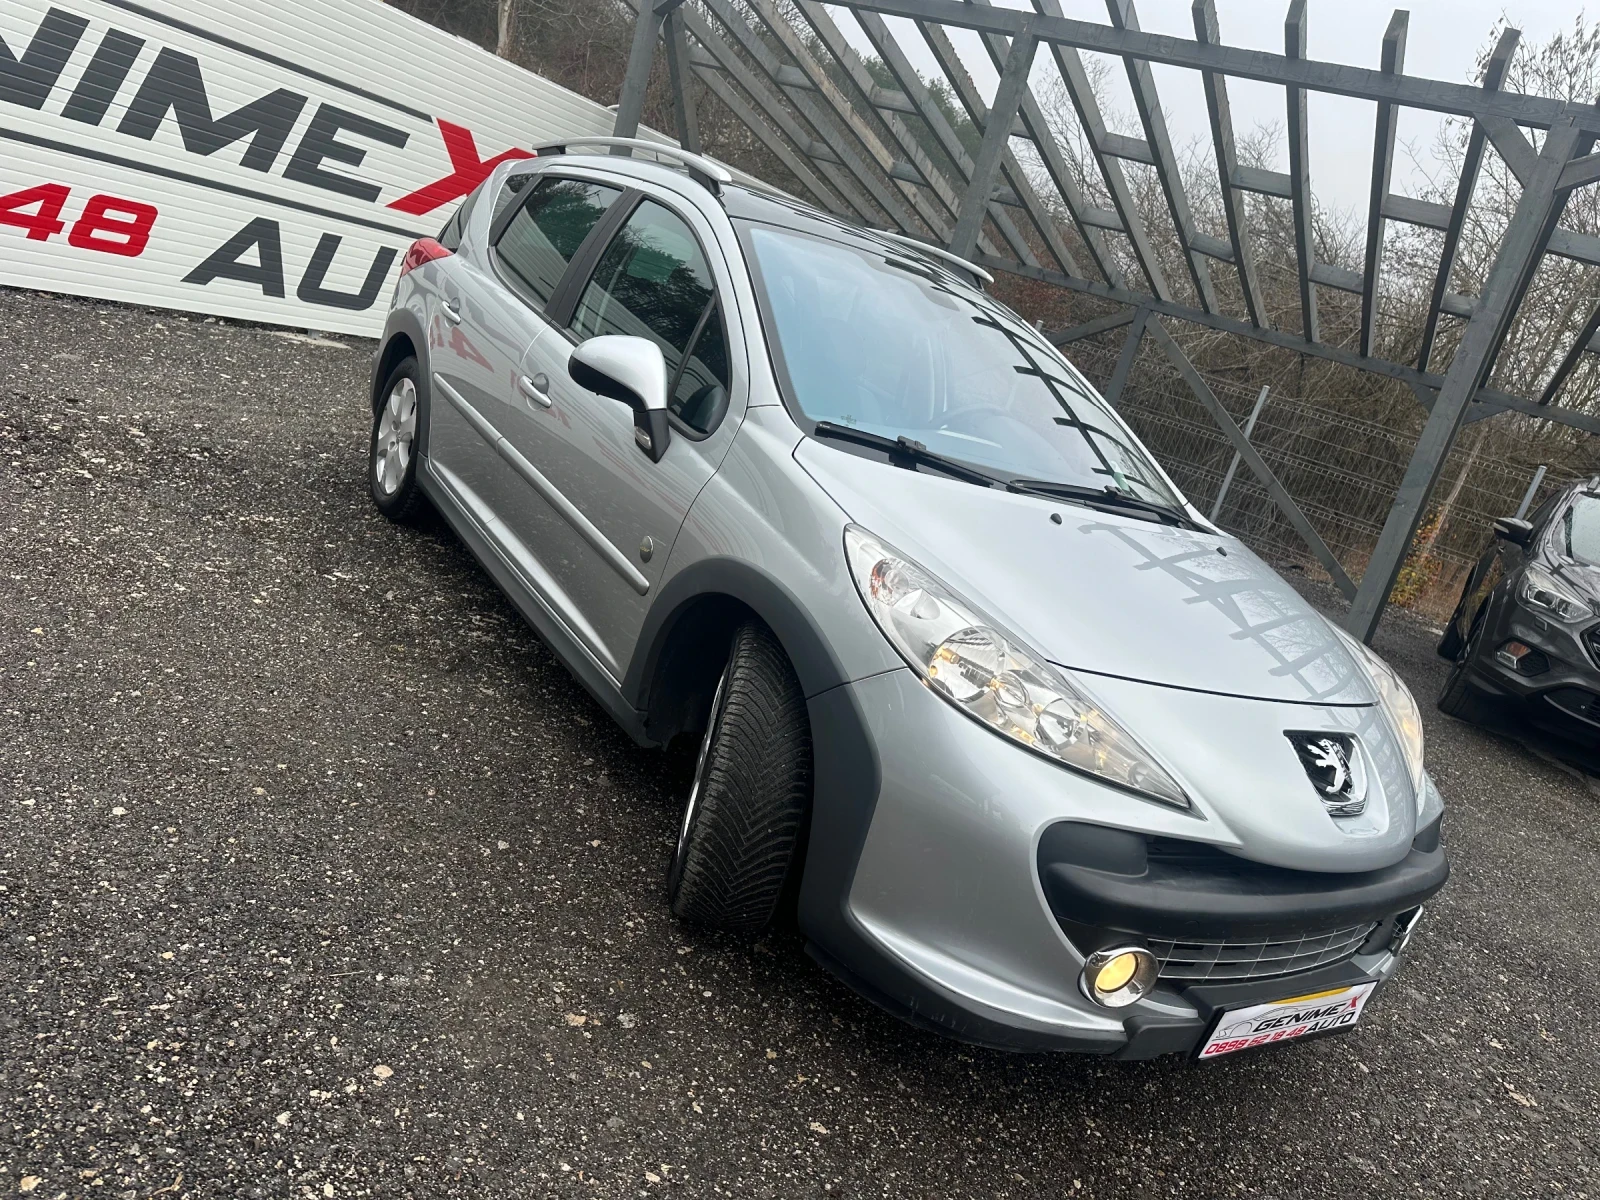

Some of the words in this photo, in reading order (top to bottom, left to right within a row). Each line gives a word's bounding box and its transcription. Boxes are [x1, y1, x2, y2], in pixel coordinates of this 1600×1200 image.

[0, 183, 158, 257] 48
[181, 217, 408, 311] AU
[1203, 1039, 1249, 1055] 0898
[1286, 1025, 1308, 1037] 48
[1304, 1011, 1356, 1033] AUTO
[1252, 990, 1368, 1033] GENIMEX
